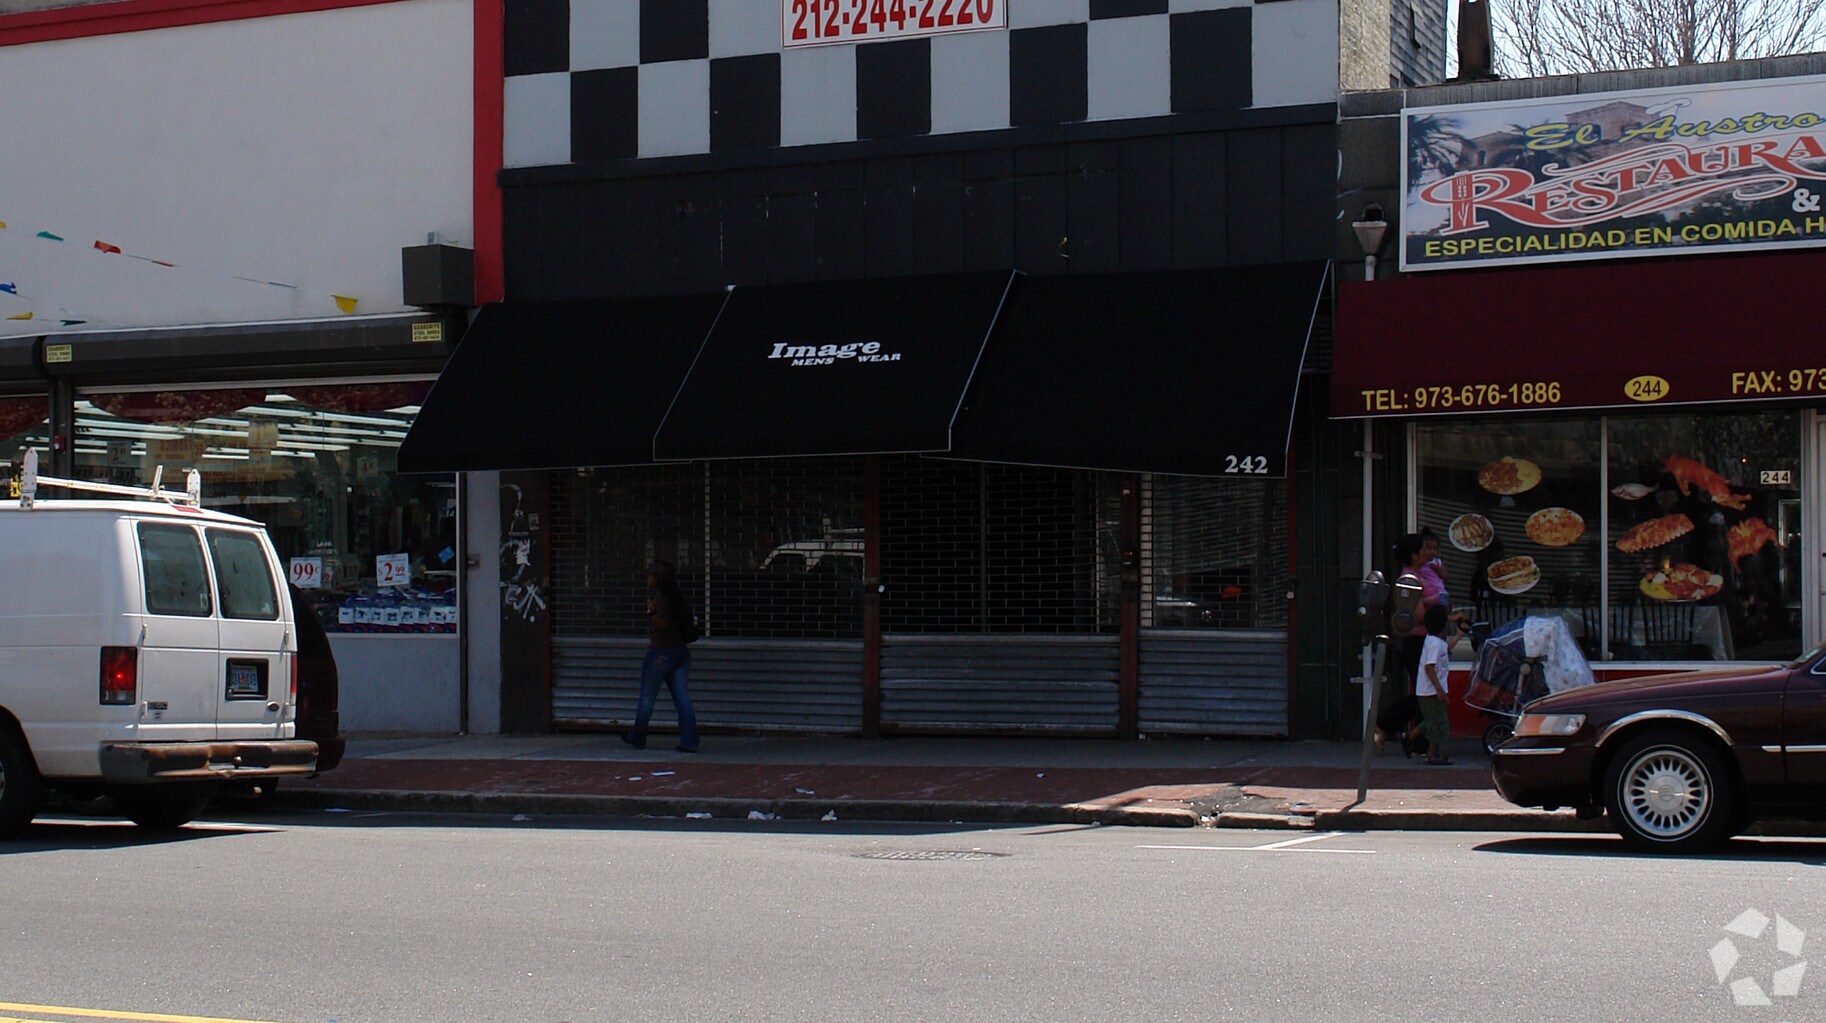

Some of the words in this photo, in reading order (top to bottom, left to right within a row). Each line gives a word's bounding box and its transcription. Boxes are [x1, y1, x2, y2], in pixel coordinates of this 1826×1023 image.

[1525, 123, 1601, 151] El
[1617, 111, 1823, 144] Austro
[1792, 188, 1821, 213] &
[1424, 230, 1627, 258] ESPECIALIDAD
[1634, 227, 1673, 246] EN
[1680, 218, 1797, 243] COMIDA
[768, 341, 881, 359] Image
[791, 357, 835, 367] MENS
[857, 353, 902, 363] WEAR
[1632, 379, 1662, 397] 244
[1732, 371, 1782, 394] FAX:
[1361, 389, 1409, 411] TEL:
[1414, 382, 1562, 408] 973-676-1886
[1224, 455, 1269, 474] 242
[1761, 471, 1789, 483] 244
